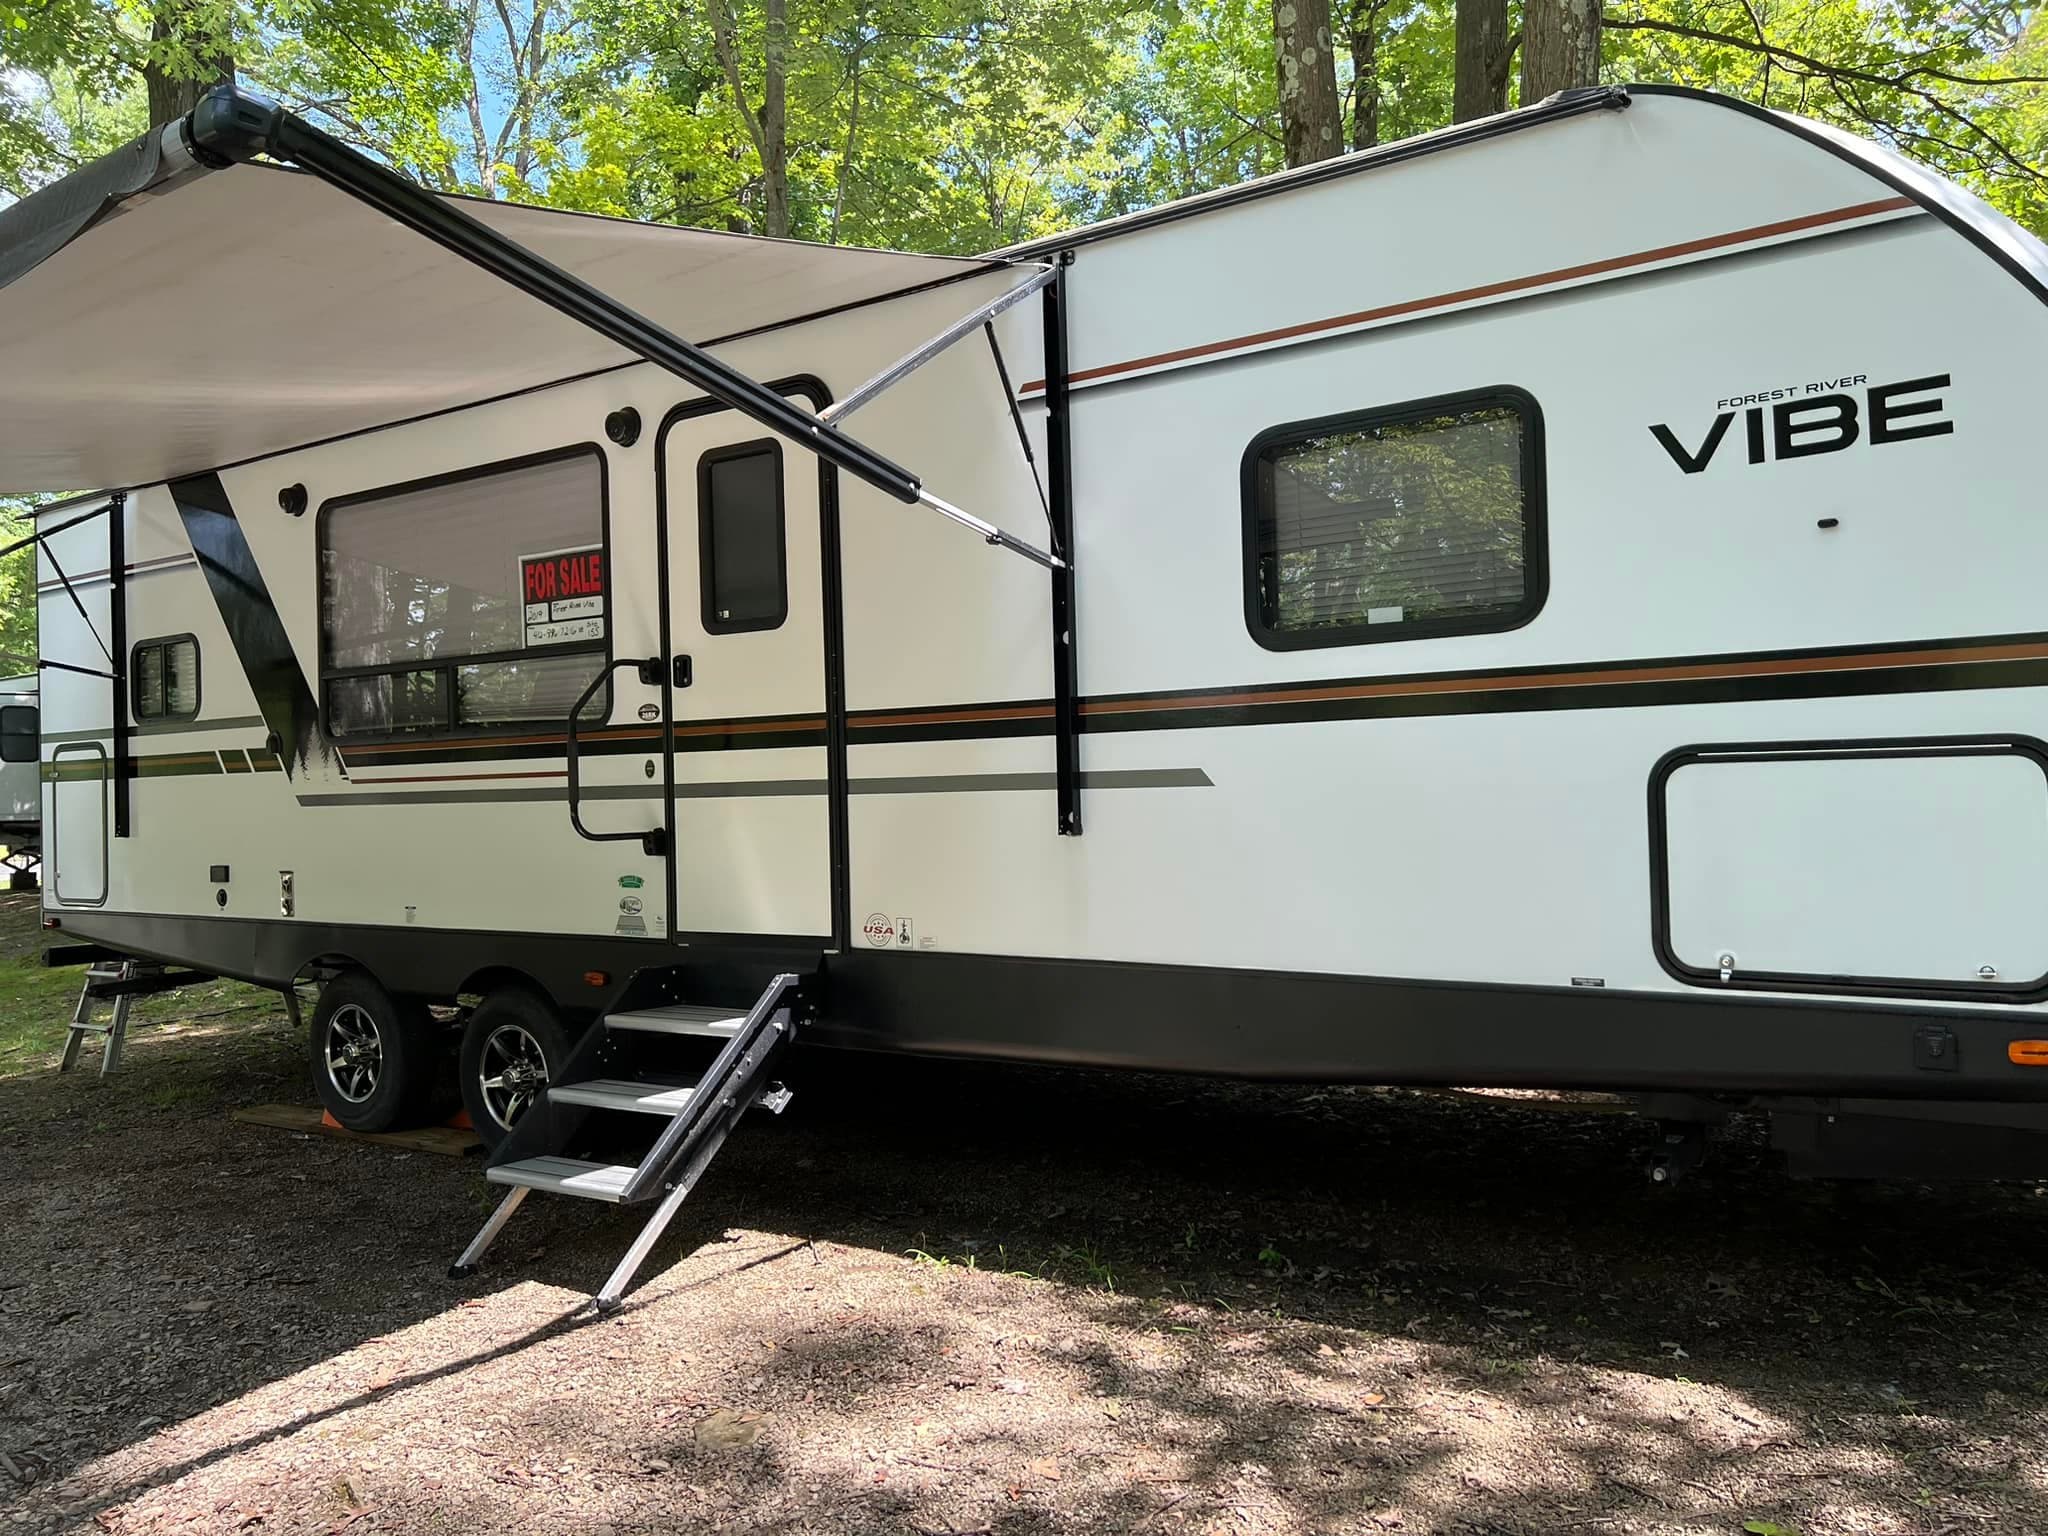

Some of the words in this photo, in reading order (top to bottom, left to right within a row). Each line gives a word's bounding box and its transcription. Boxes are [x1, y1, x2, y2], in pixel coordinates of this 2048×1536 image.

[1717, 386, 1798, 410] FOREST
[1805, 374, 1868, 394] RIVER
[1648, 373, 1954, 474] VIBE
[526, 562, 556, 601] FOR
[559, 555, 602, 595] SALE
[863, 925, 895, 935] USA
